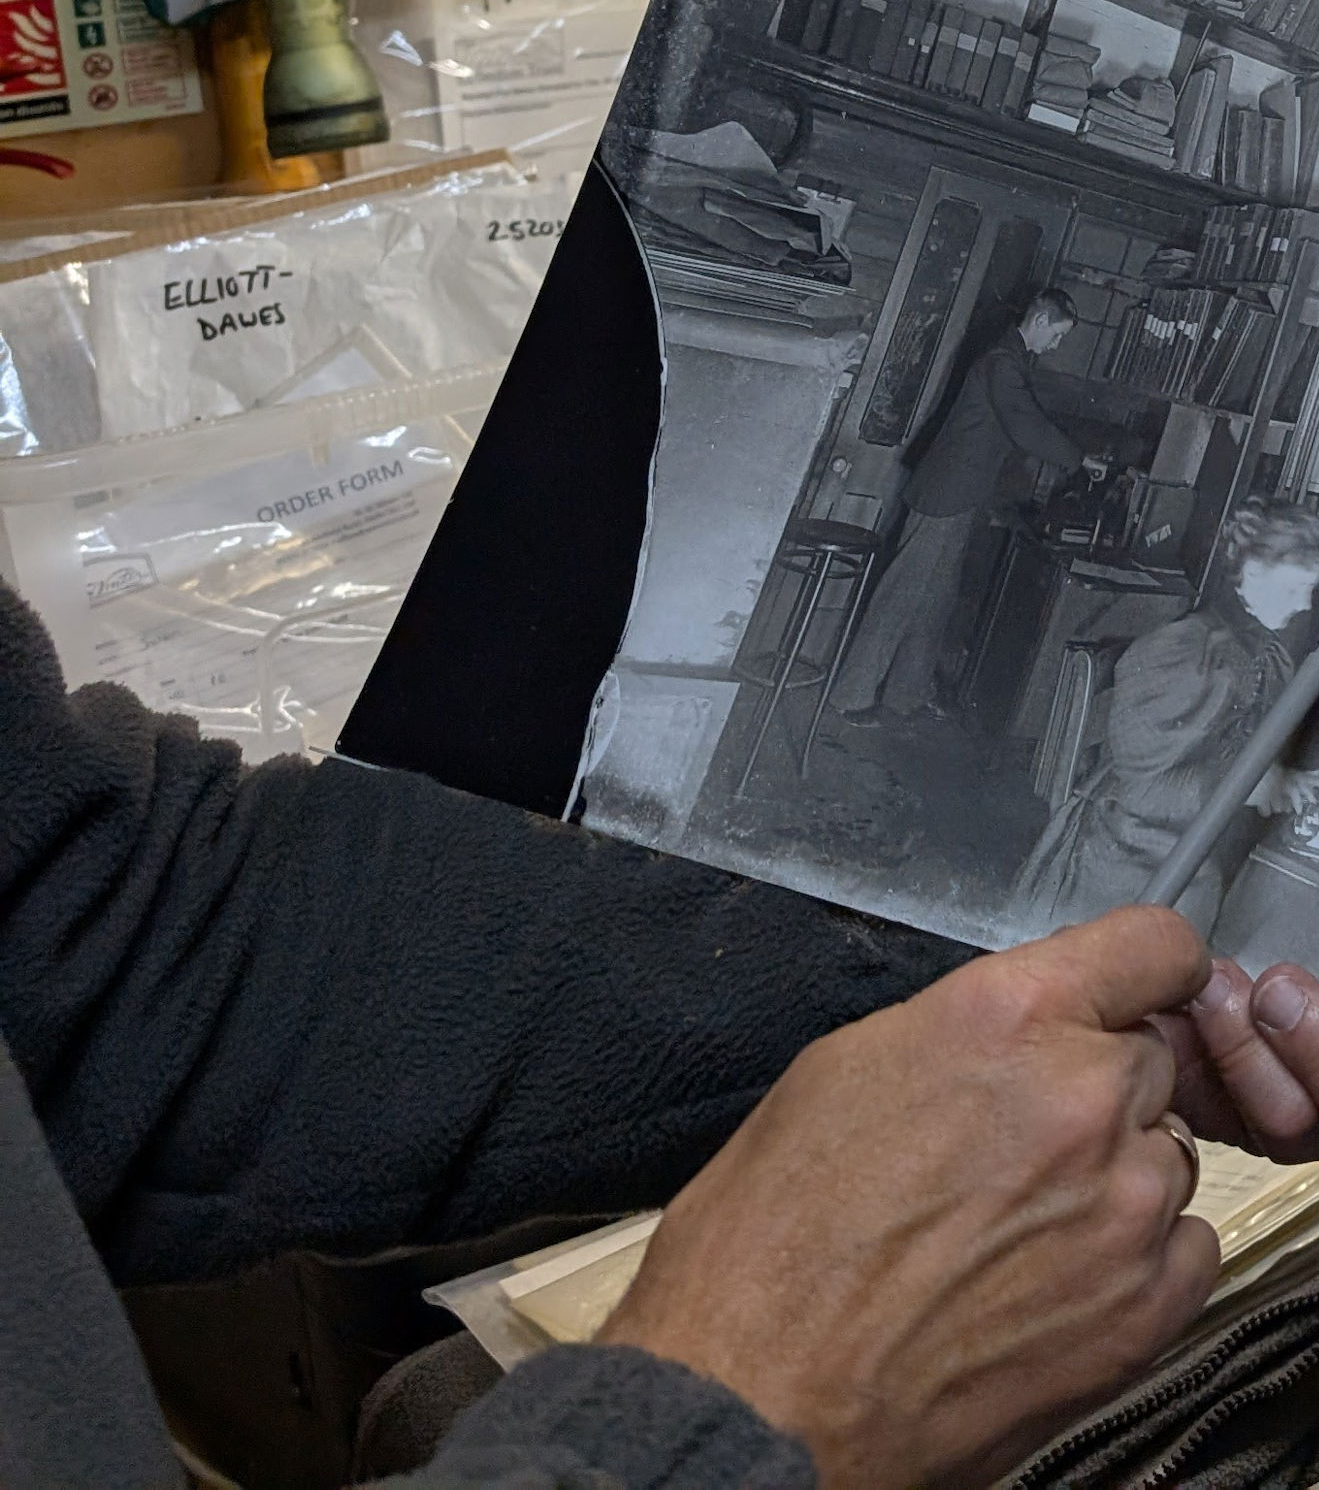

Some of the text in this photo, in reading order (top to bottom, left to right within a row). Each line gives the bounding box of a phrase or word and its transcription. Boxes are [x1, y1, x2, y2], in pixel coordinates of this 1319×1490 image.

[163, 263, 294, 311] ELLIOTT-
[197, 302, 286, 341] DAWES
[256, 460, 405, 523] ORDER FORM
